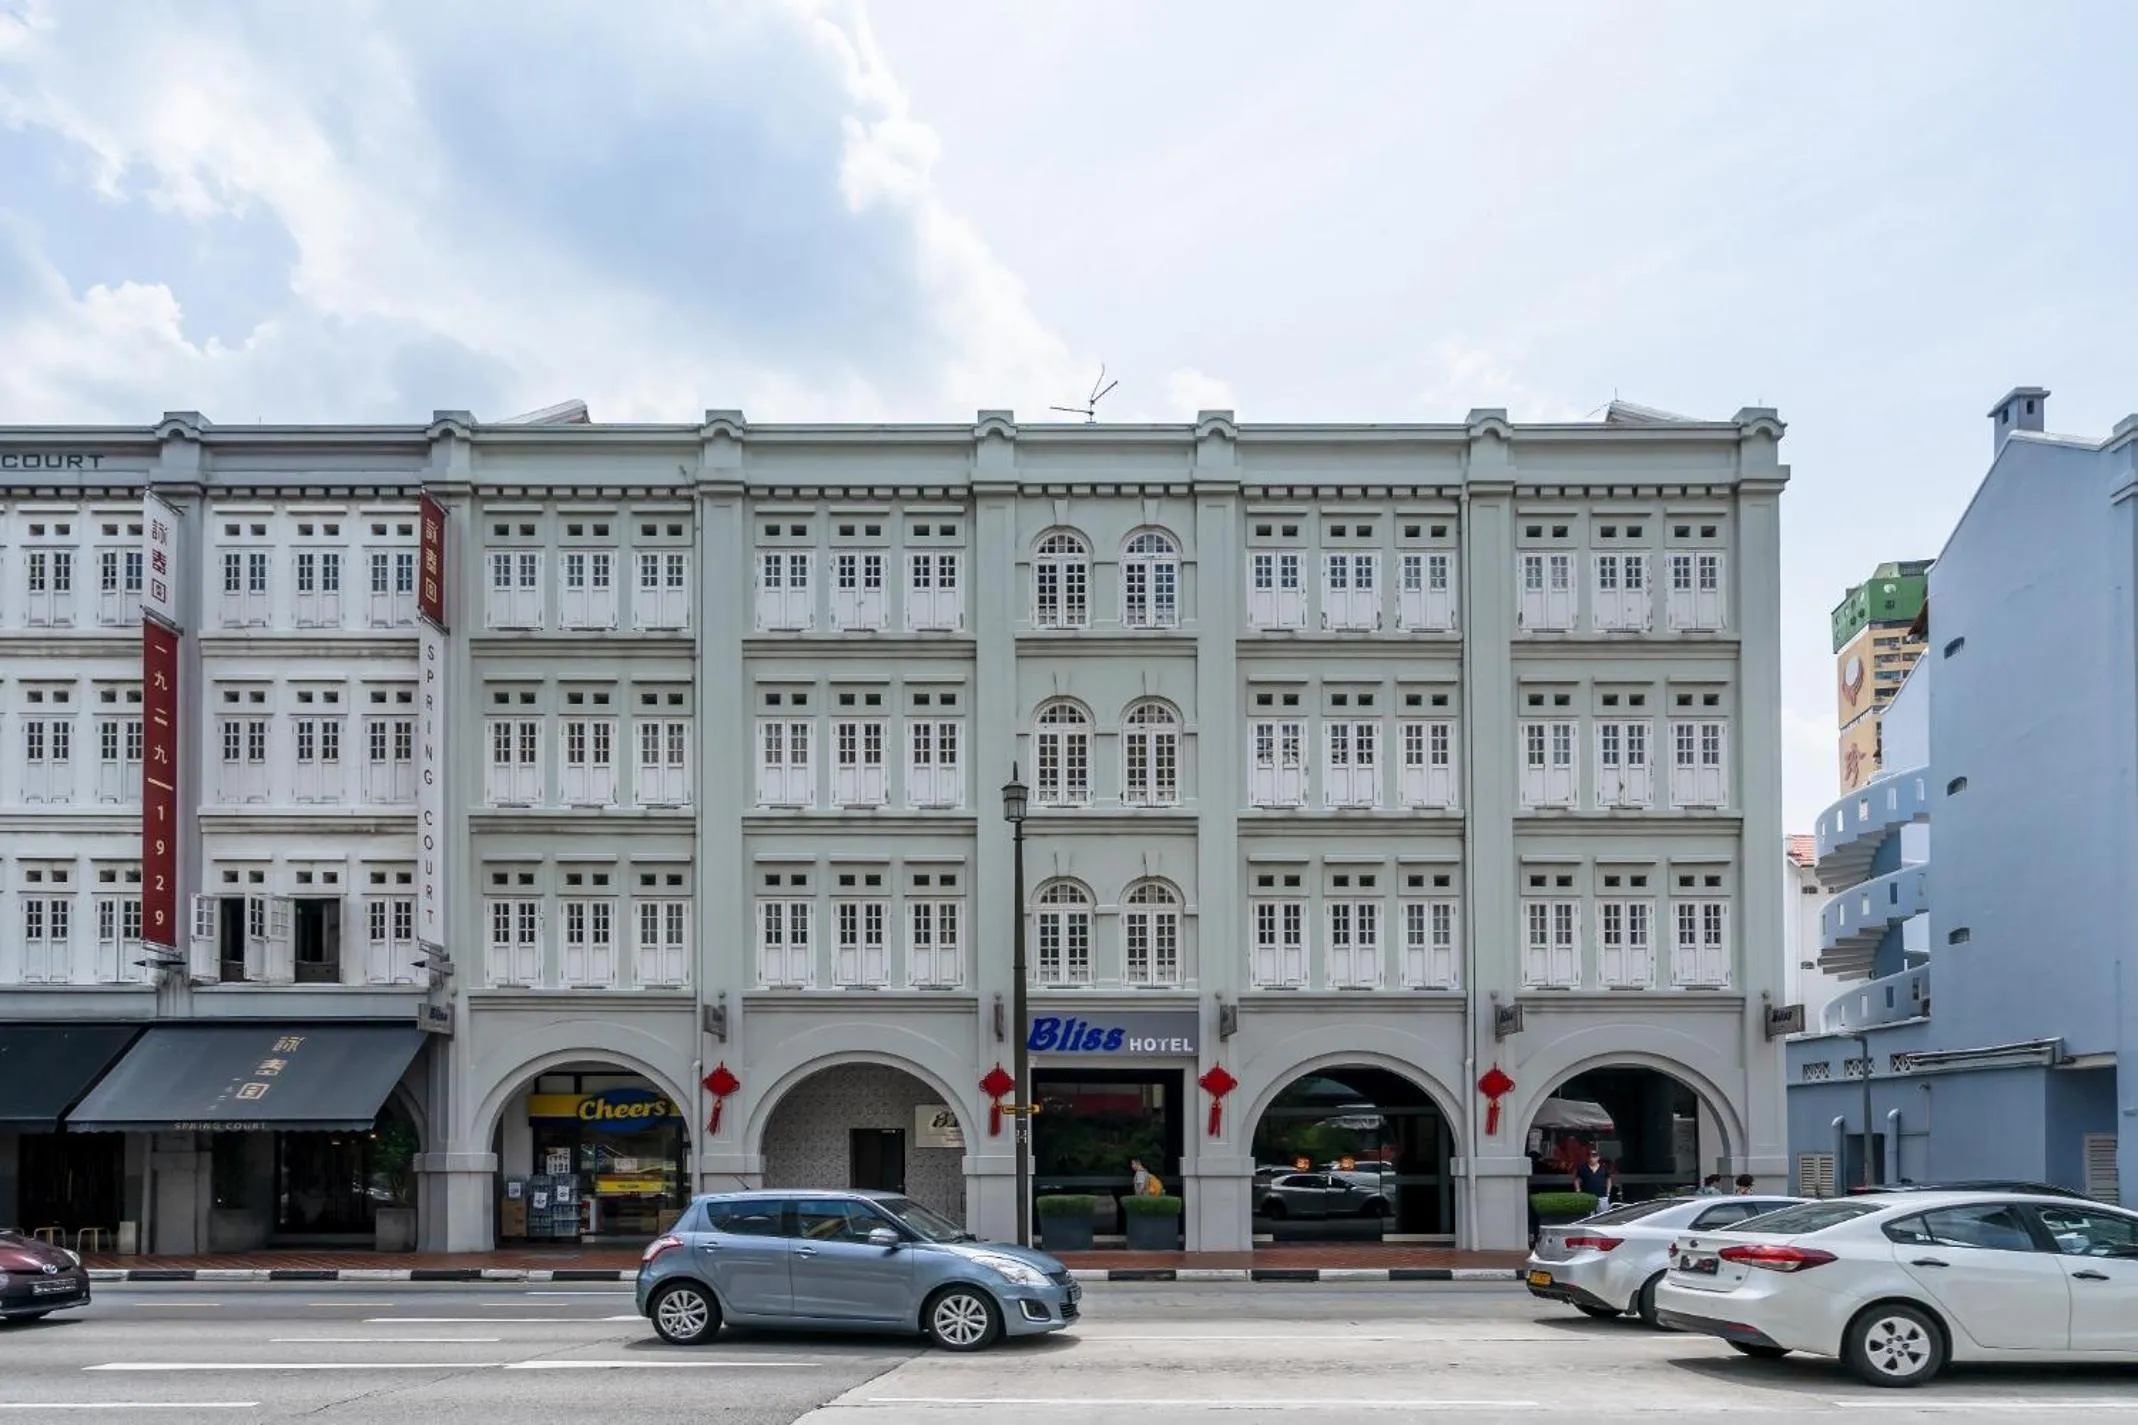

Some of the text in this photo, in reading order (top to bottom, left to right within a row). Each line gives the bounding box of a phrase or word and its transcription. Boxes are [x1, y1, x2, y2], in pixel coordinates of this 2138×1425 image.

[2, 454, 104, 469] COURT
[153, 643, 168, 927] 一九二九 1929
[423, 643, 436, 926] SPRING COURT
[1027, 1016, 1194, 1053] Bliss HOTEL
[578, 1096, 668, 1121] Cheers
